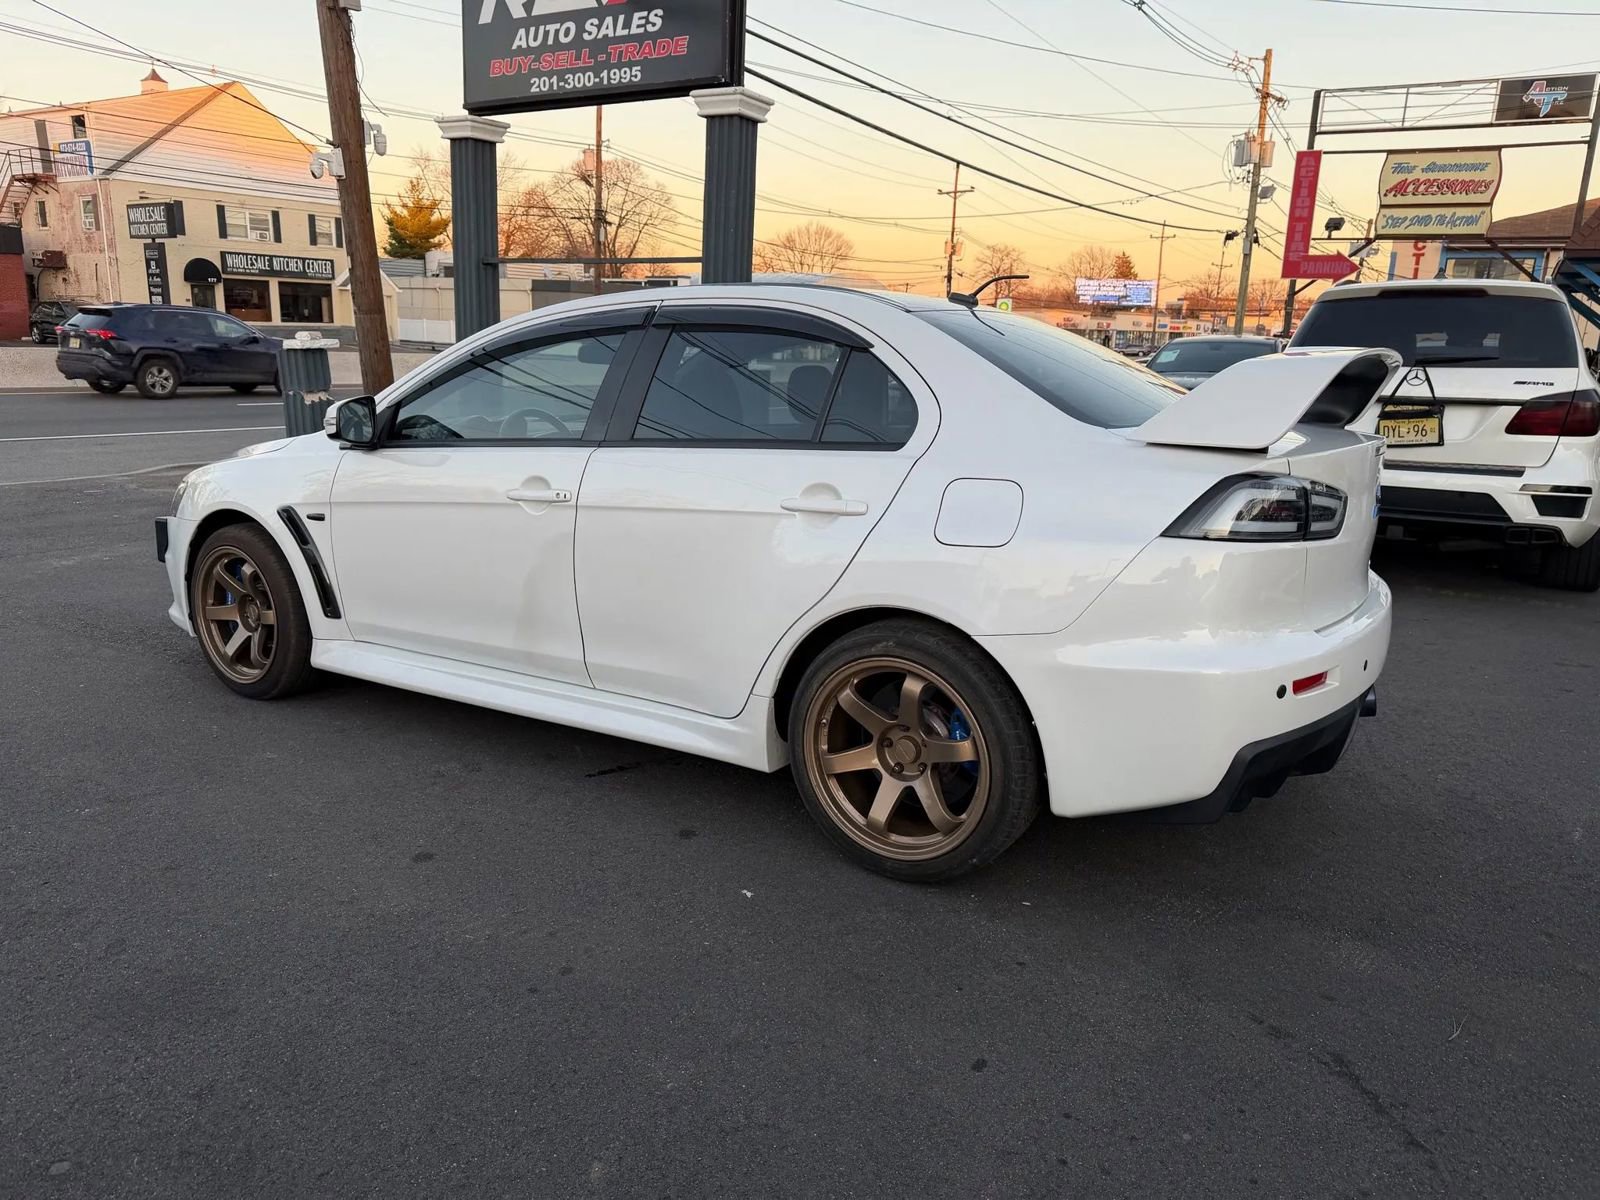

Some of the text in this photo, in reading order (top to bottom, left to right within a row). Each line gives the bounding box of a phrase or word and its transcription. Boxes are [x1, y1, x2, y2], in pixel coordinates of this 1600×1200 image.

[511, 18, 575, 50] AUTO
[582, 8, 664, 41] SALES
[530, 66, 642, 93] 201-300-1995
[1383, 178, 1494, 198] ACCESSORIES
[128, 206, 166, 223] WHOLESALE
[130, 222, 168, 236] KITCHEN CENTER
[225, 253, 271, 271] WHOLESALE
[272, 256, 303, 273] KITCHEN
[304, 259, 333, 274] CENTER
[1300, 261, 1351, 274] PARKING
[1412, 423, 1428, 438] 96
